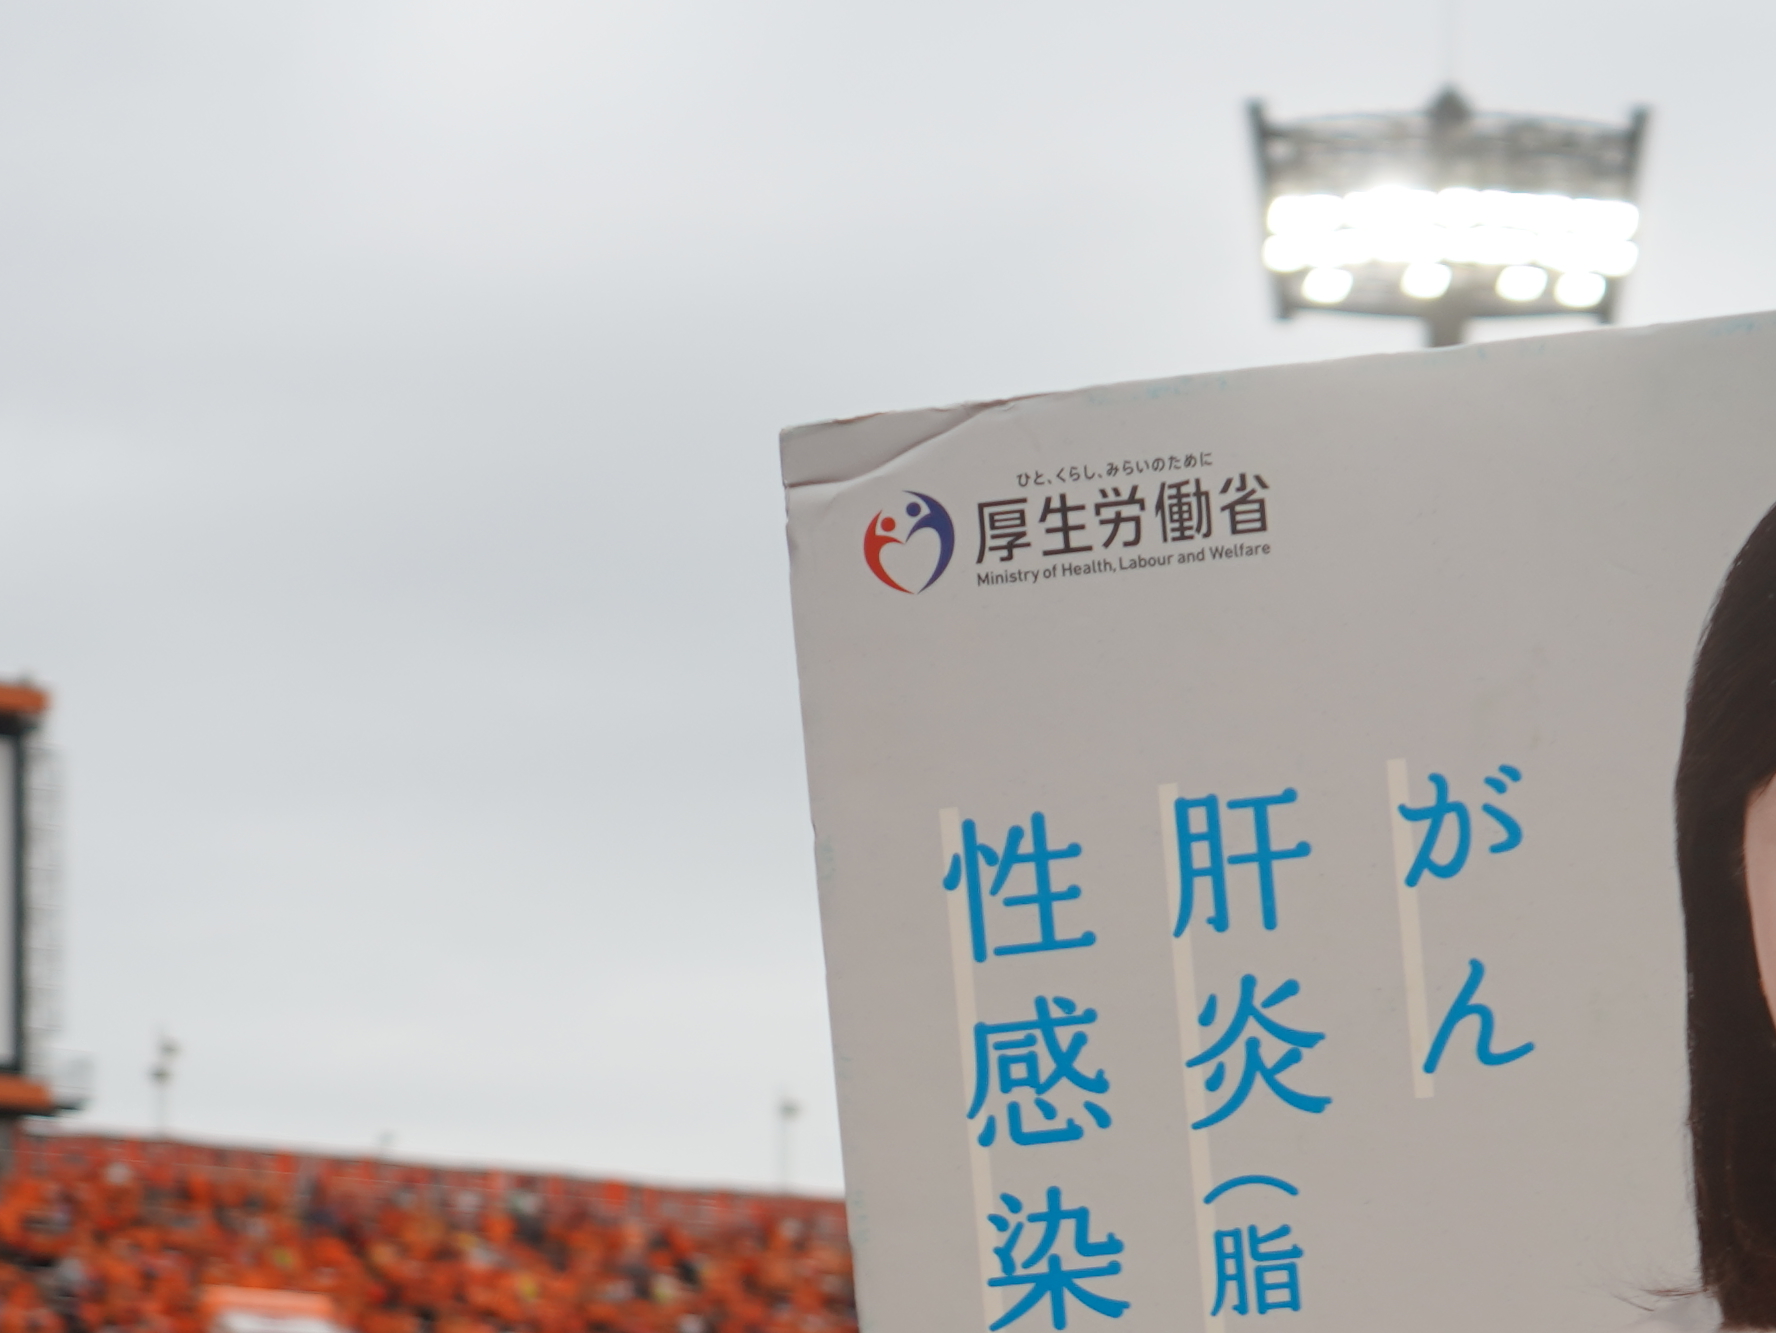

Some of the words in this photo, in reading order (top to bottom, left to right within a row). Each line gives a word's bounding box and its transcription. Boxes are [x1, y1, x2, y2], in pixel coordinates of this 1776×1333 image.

[1017, 452, 1213, 488] ひと、くらし、みらいのために
[976, 472, 1271, 565] 厚生労働省
[977, 567, 1040, 587] Ministry
[1042, 563, 1060, 579] of
[1061, 559, 1117, 578] Health,
[1118, 553, 1174, 572] Labour
[1176, 548, 1205, 565] and
[1208, 541, 1272, 561] Welfare
[1397, 763, 1536, 1075] がん
